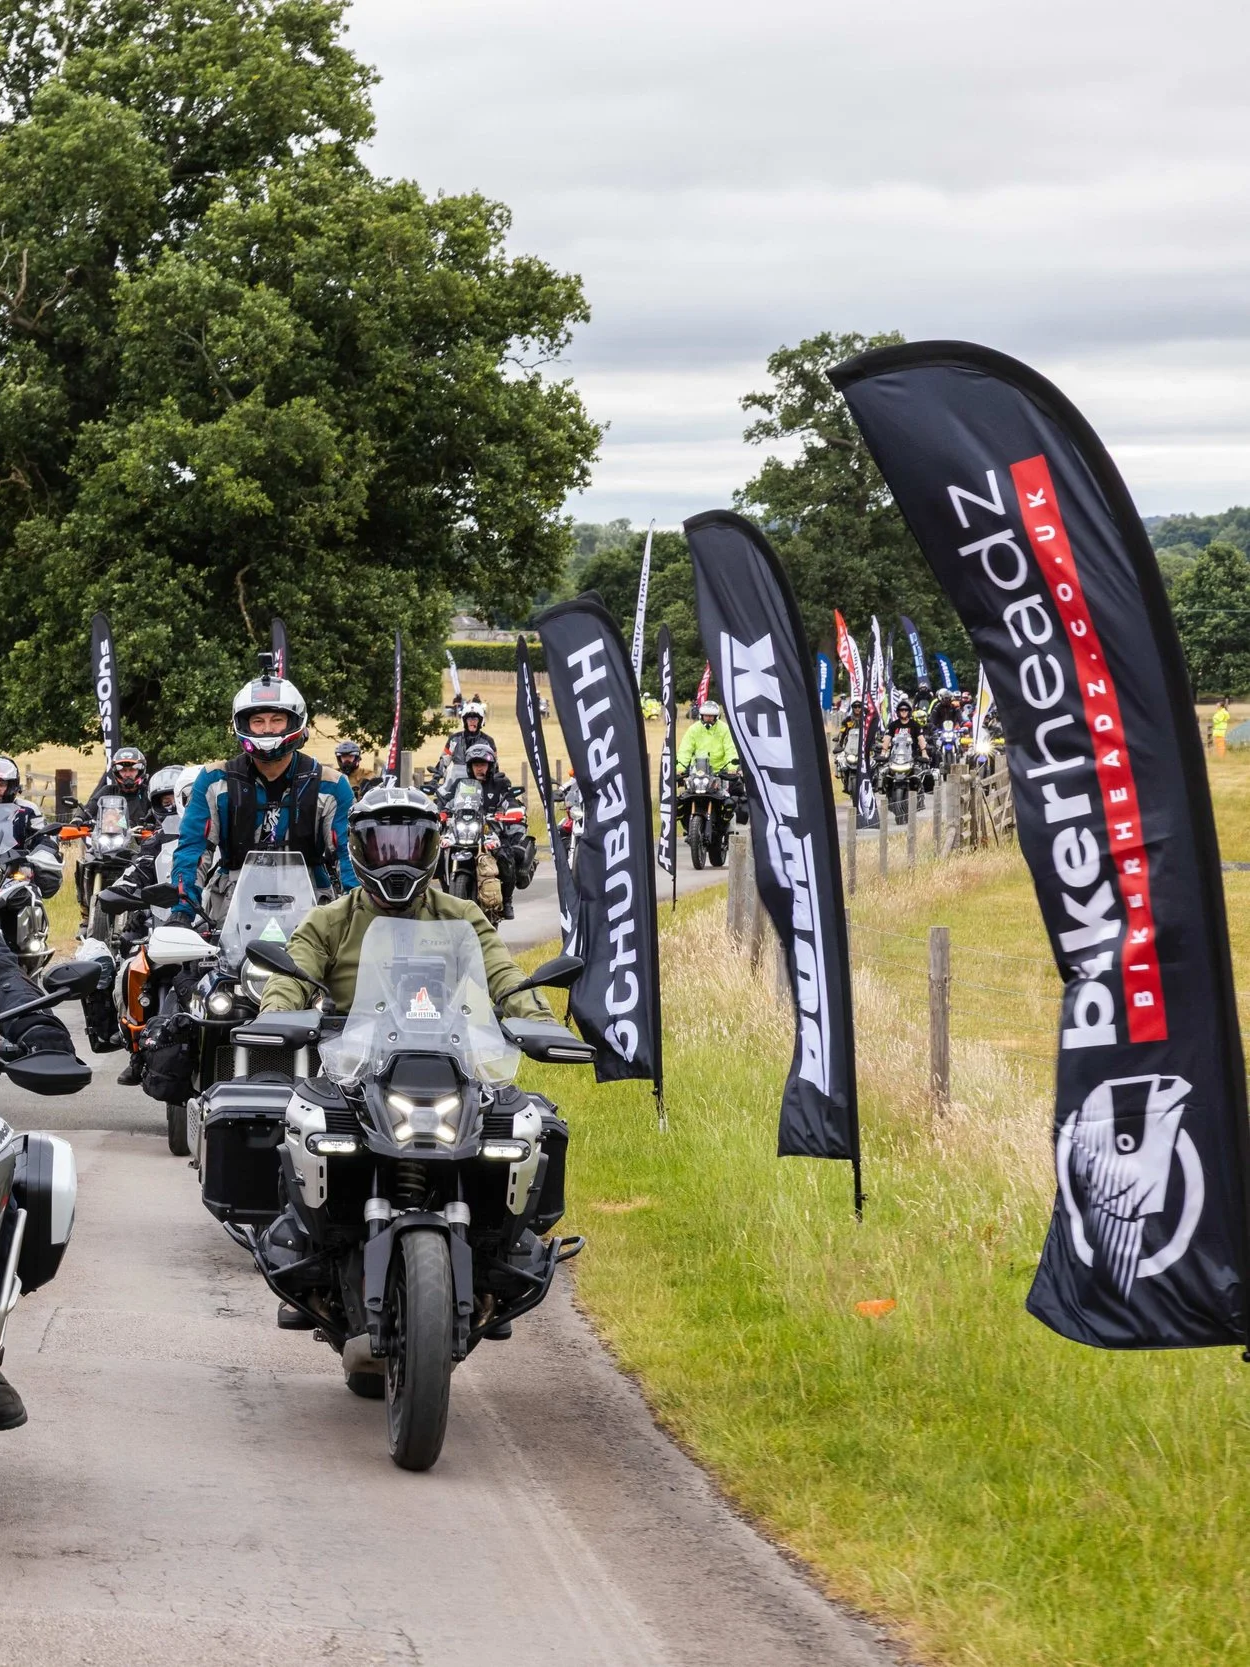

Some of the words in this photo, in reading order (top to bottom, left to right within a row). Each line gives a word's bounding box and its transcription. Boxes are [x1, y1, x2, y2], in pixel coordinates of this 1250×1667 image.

[567, 638, 639, 1063] SCHUBERTH
[947, 470, 1121, 1049] bikerheadz
[1026, 488, 1154, 1007] BIKERHEADZ.CO.UK
